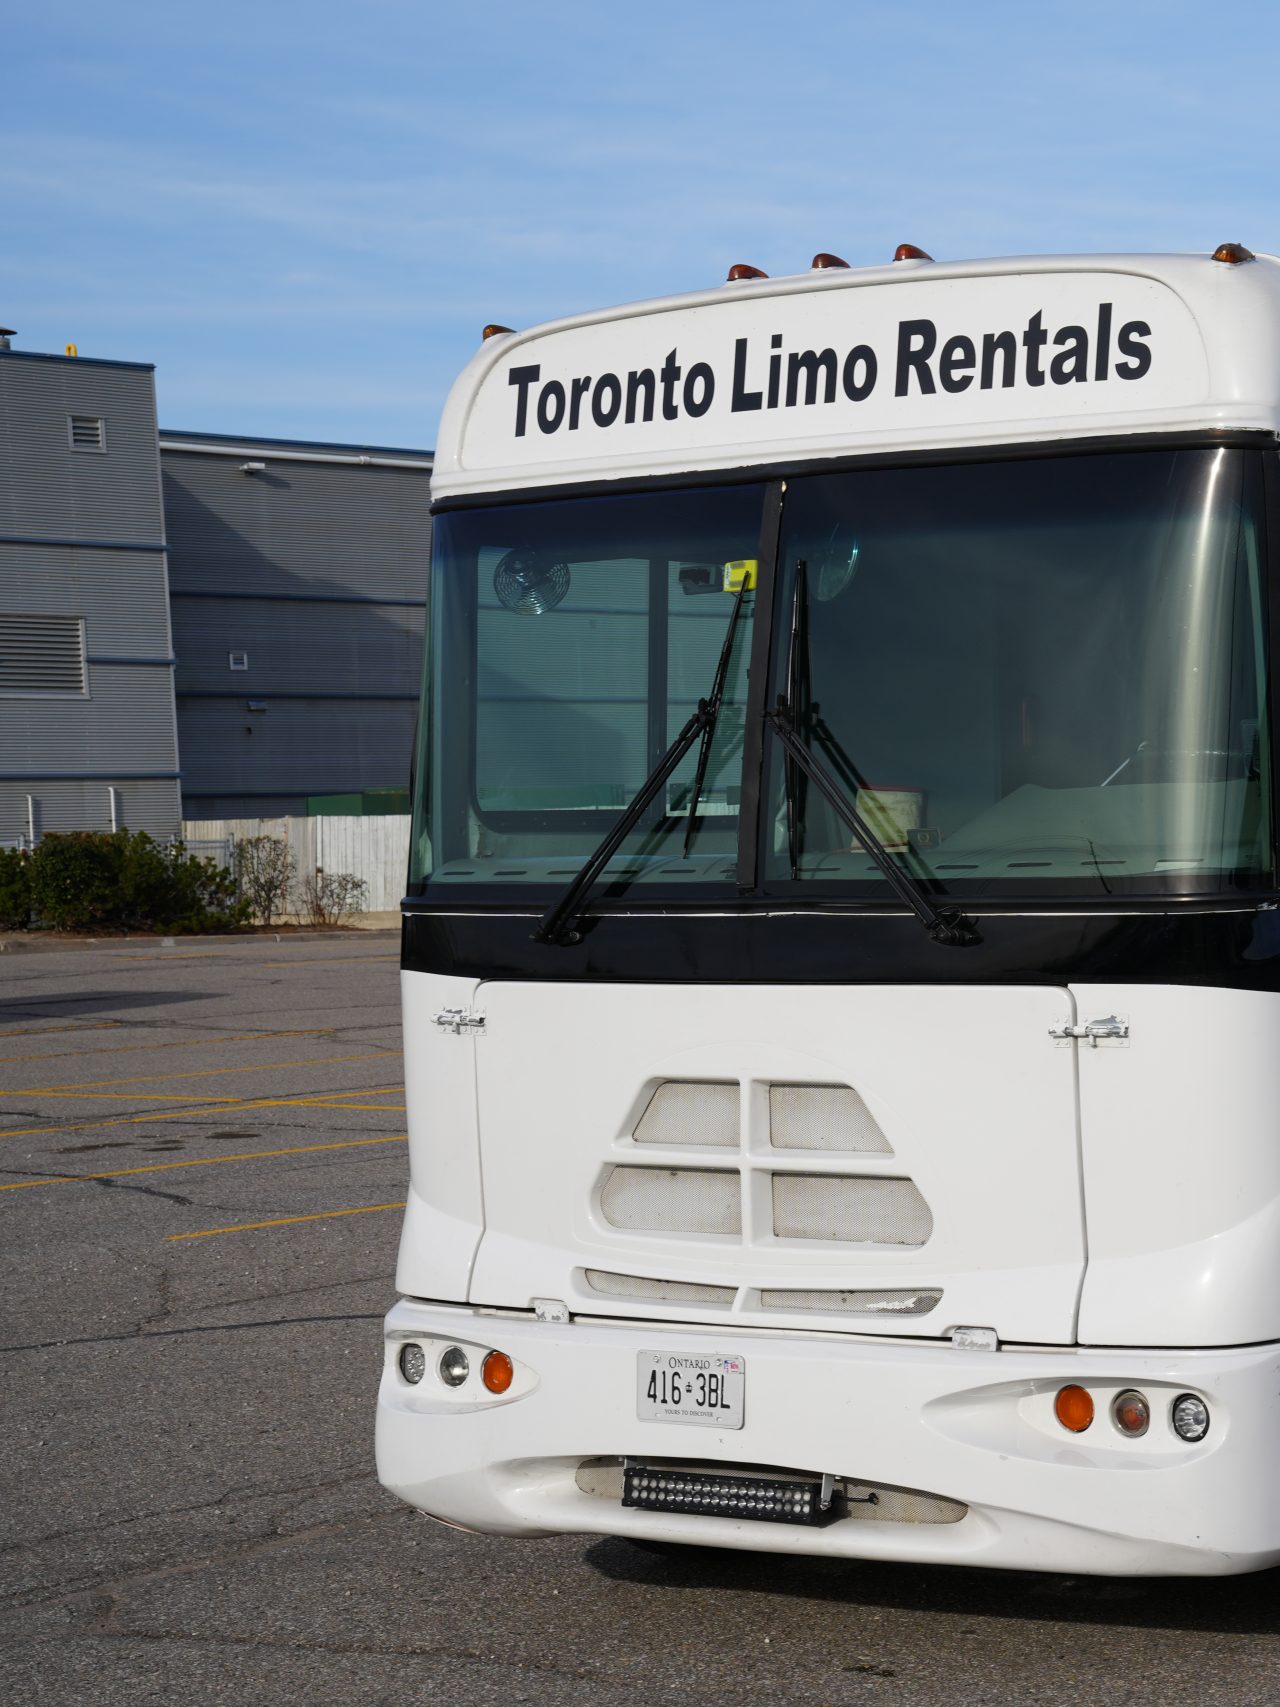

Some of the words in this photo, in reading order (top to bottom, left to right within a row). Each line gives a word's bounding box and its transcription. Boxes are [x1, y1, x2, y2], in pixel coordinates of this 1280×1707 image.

[508, 348, 714, 438] Toronto
[731, 334, 877, 412] Limo
[895, 303, 1152, 397] Rentals
[668, 1357, 711, 1370] ONTARIO
